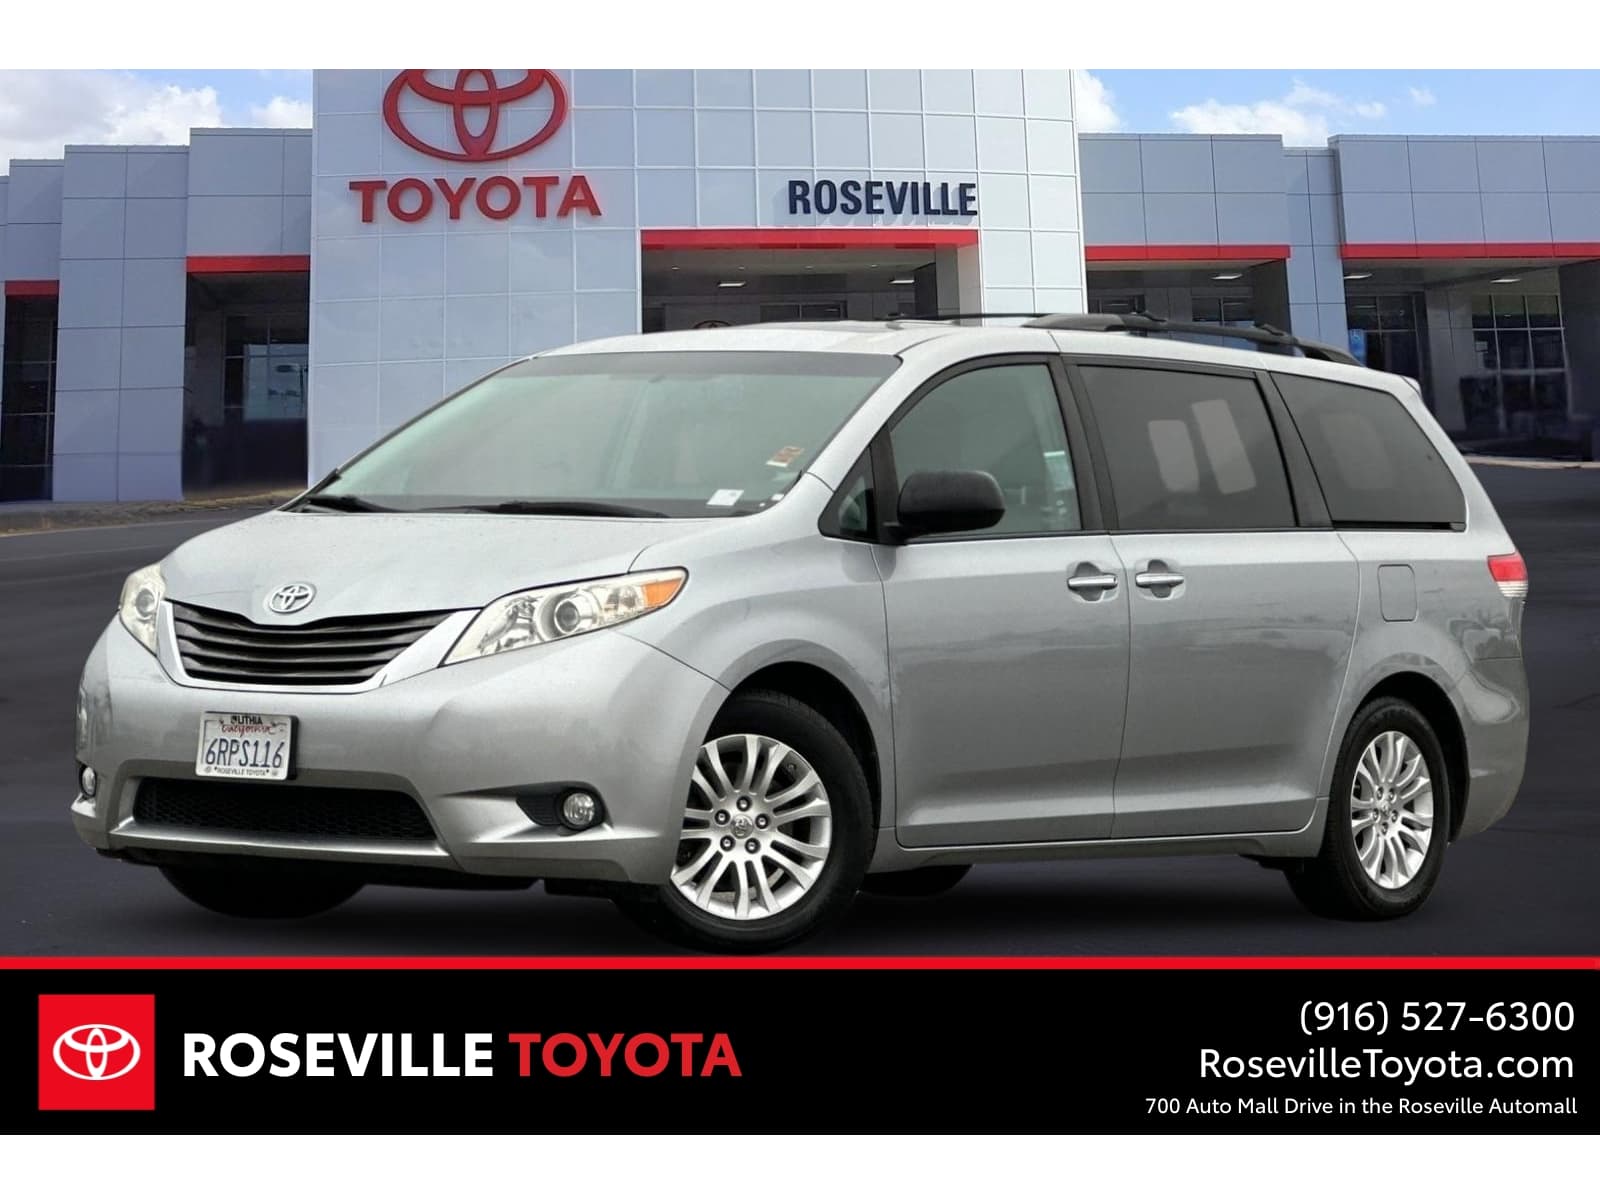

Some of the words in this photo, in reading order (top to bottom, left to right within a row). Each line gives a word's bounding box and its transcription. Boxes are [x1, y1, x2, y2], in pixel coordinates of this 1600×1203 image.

[349, 175, 602, 223] TOYOTA
[788, 179, 978, 216] ROSEVILLE
[238, 715, 263, 725] LITHIA
[206, 738, 285, 768] 6RPS116
